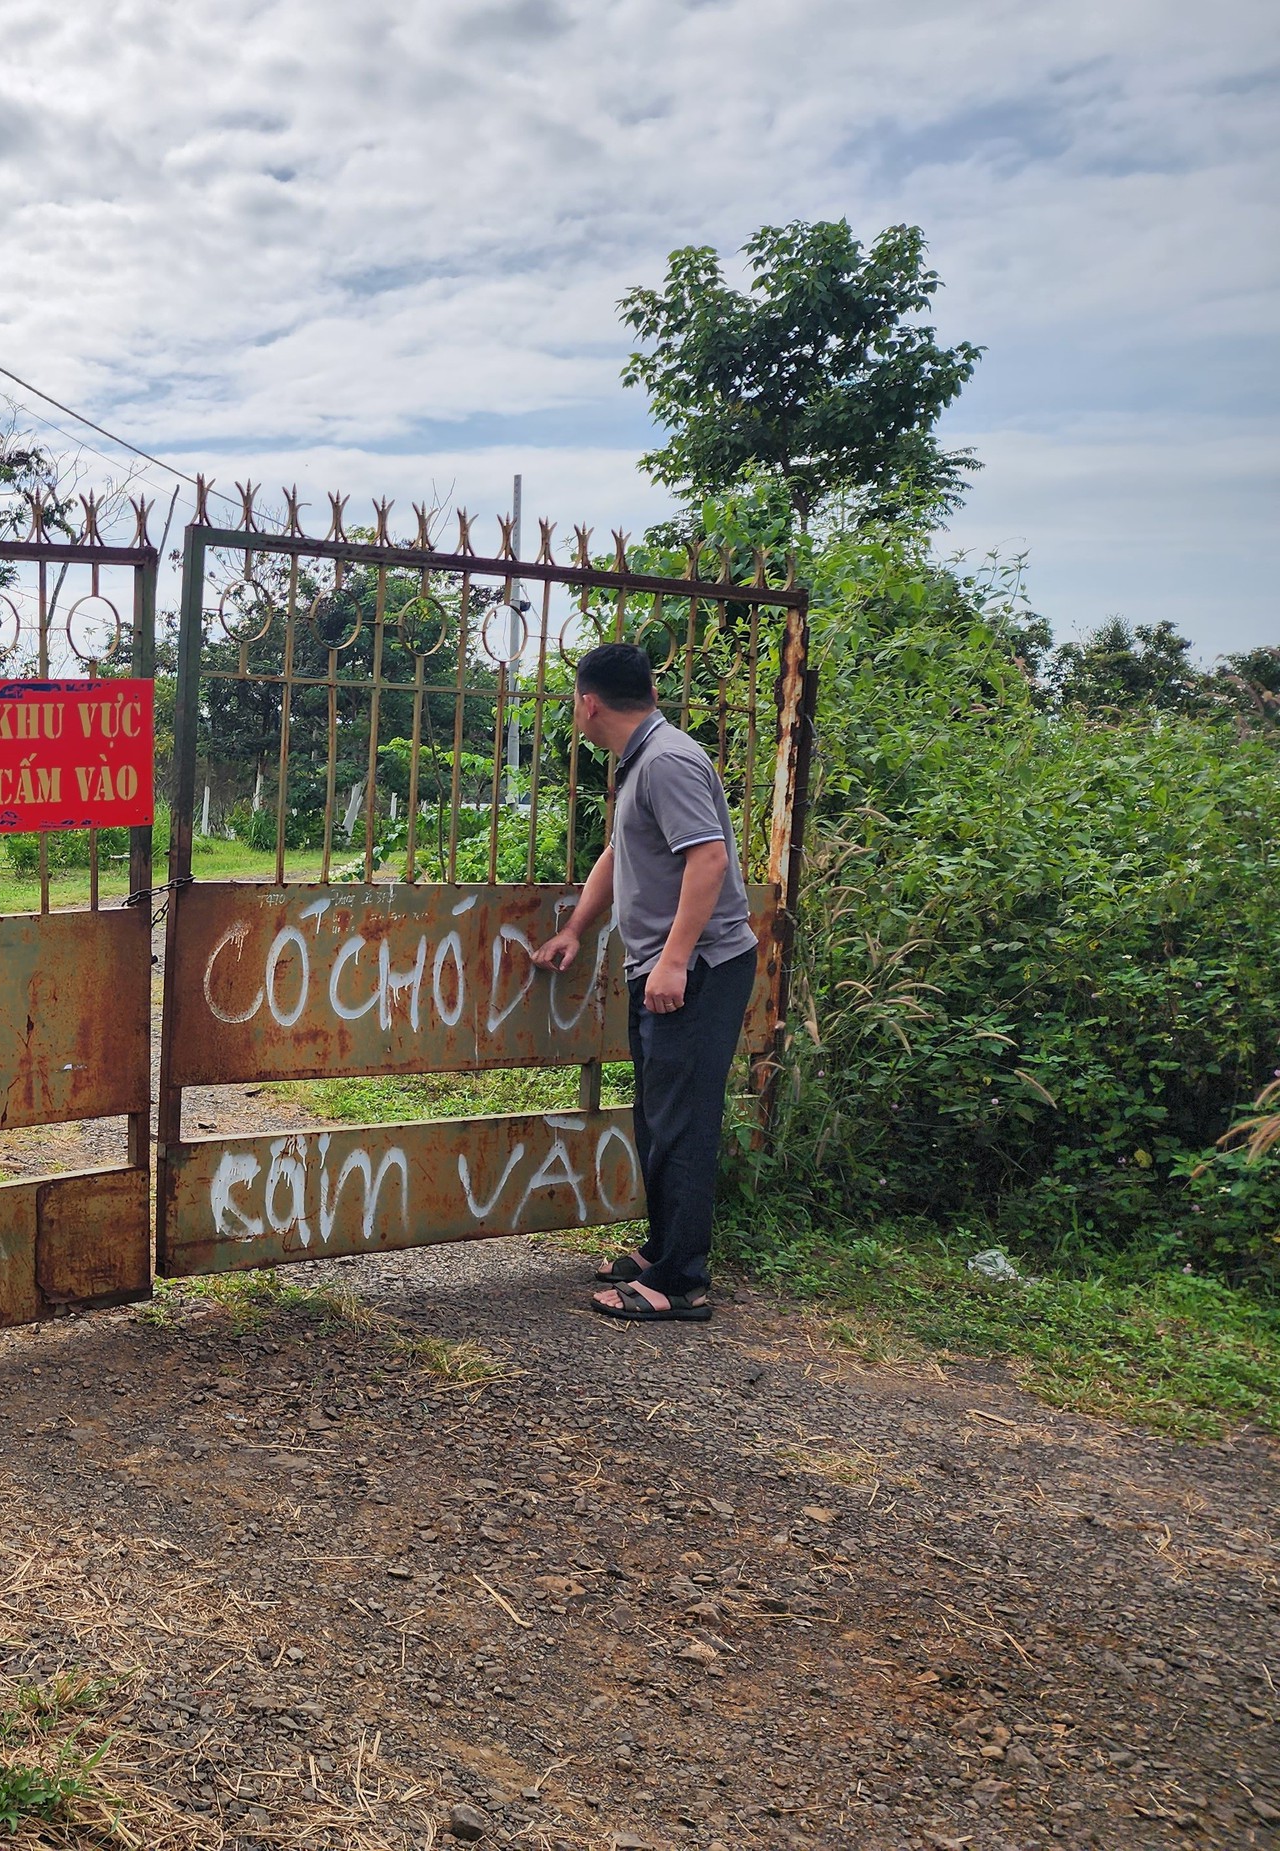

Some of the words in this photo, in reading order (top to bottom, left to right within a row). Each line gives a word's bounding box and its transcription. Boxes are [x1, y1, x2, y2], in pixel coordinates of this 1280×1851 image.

[77, 692, 141, 749] VỰC
[74, 753, 139, 802] VÀO
[203, 898, 331, 1027] CÓ
[329, 894, 478, 1032] CHÓ
